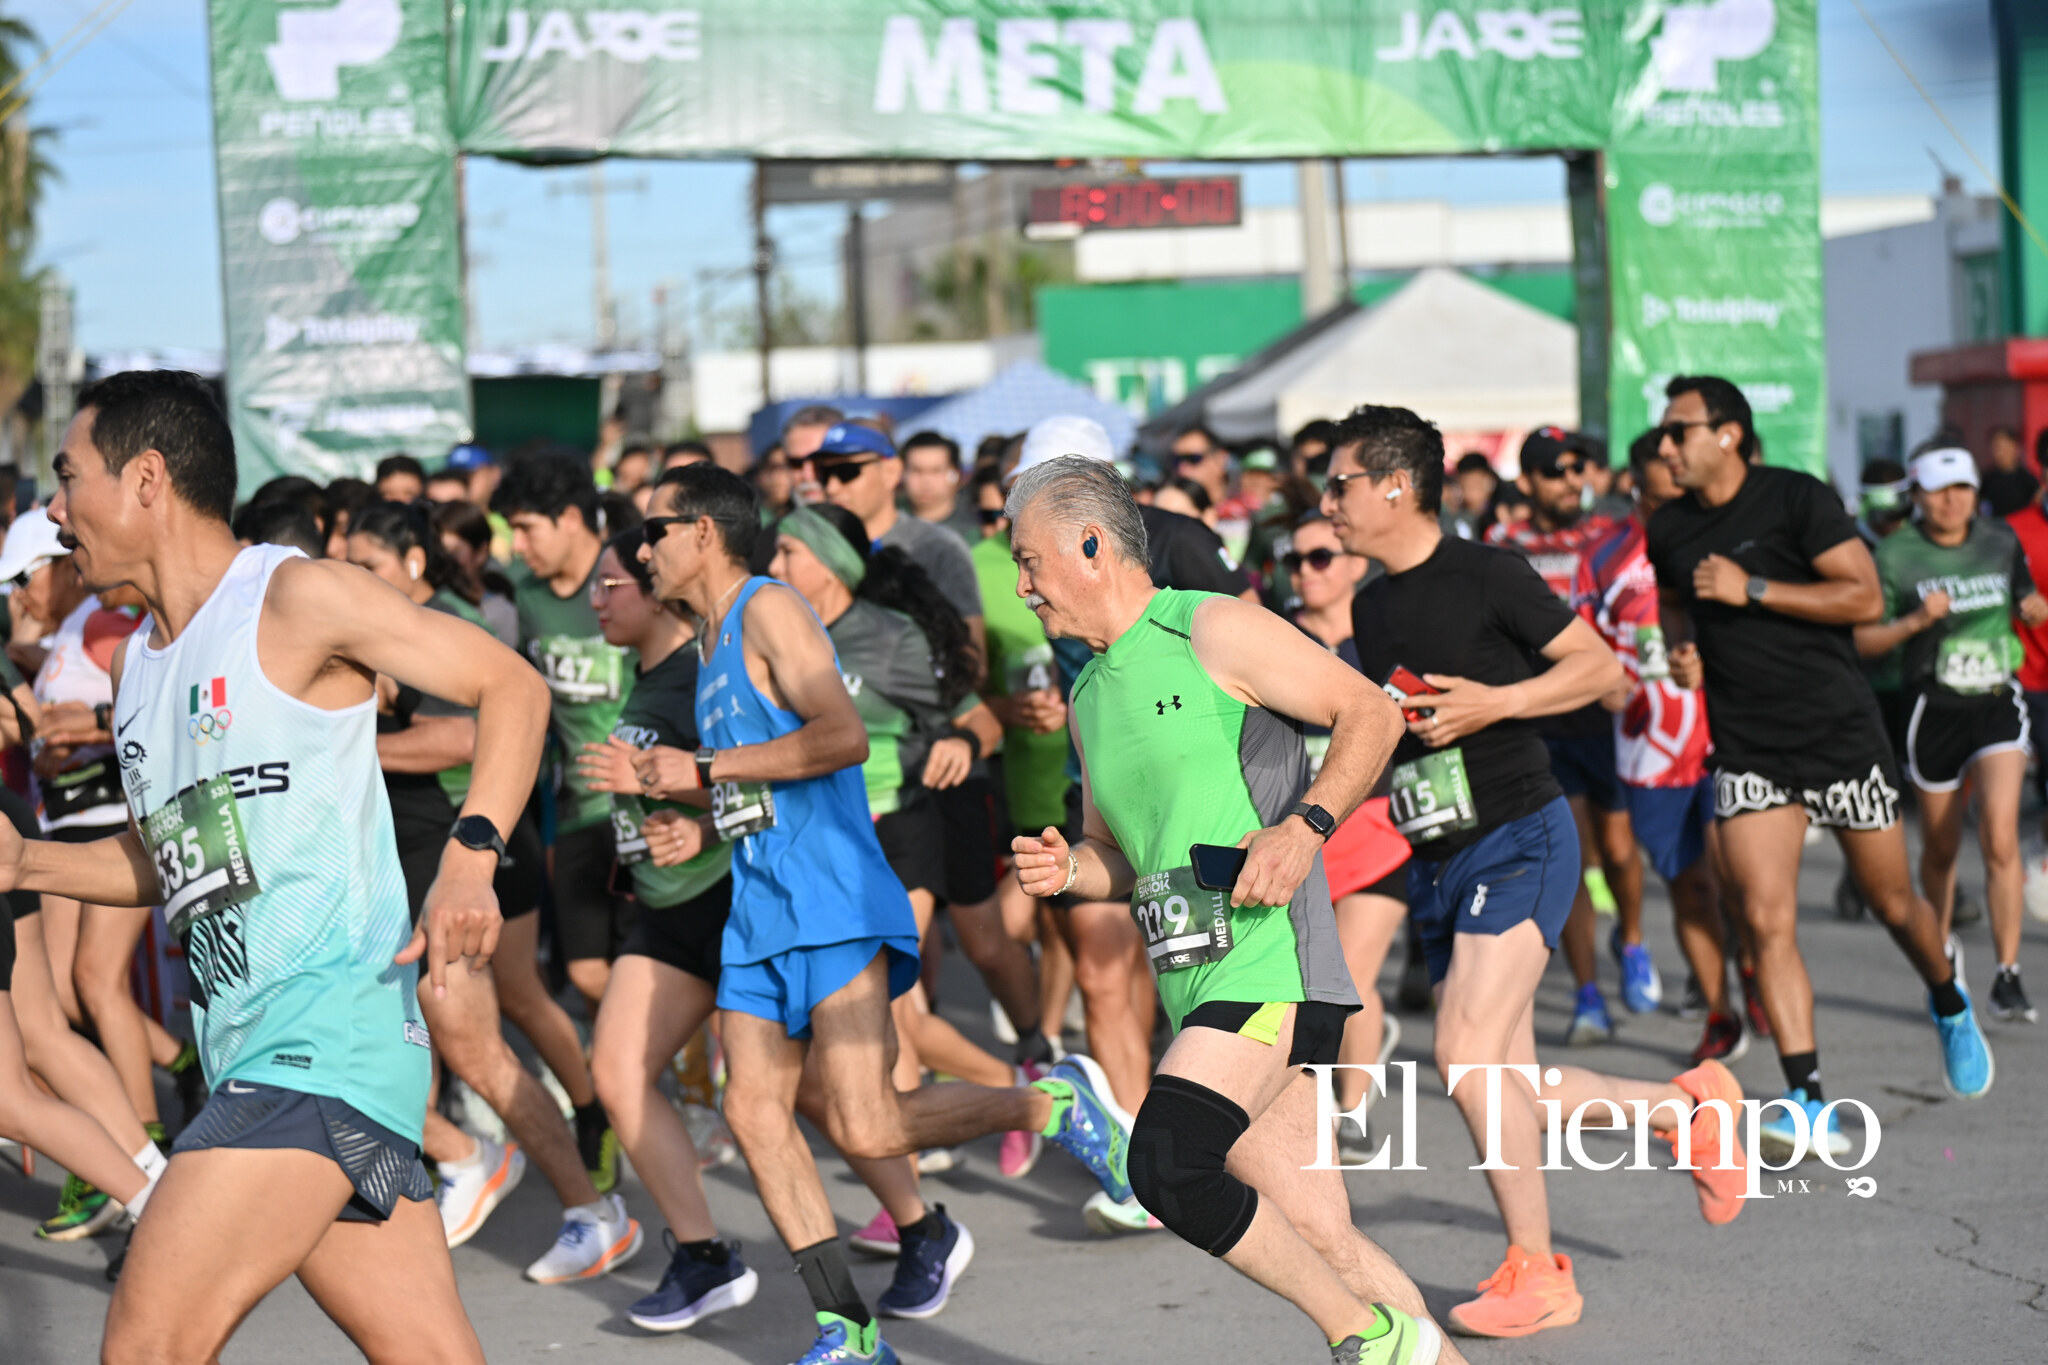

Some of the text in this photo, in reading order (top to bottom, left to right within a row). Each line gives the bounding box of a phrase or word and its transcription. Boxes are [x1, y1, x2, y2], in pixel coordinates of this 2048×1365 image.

[873, 16, 1230, 114] META
[544, 653, 594, 684] 147
[154, 825, 206, 901] 535
[218, 802, 251, 886] MEDALLA
[1137, 894, 1190, 943] 229
[1211, 891, 1228, 948] MEDALL
